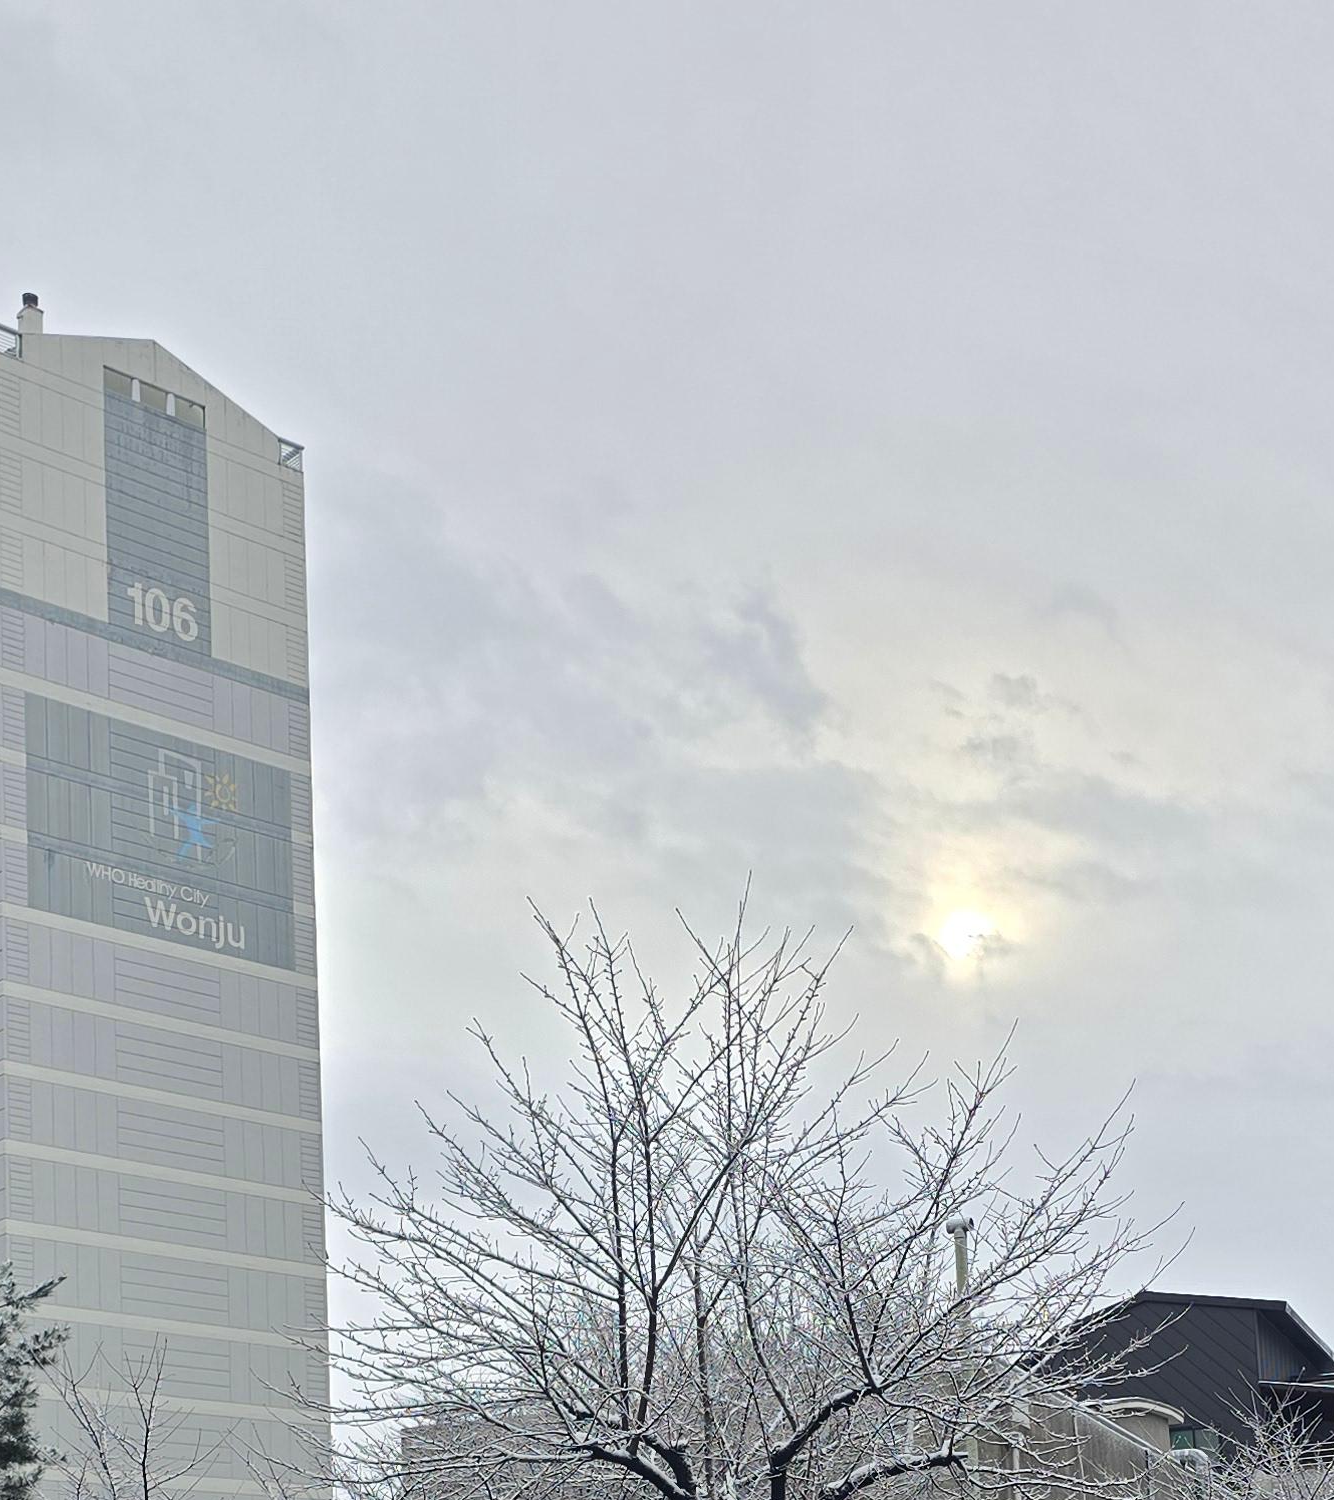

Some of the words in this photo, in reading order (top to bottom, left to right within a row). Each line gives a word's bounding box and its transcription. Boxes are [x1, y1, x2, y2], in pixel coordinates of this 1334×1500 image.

[127, 582, 198, 642] 106
[85, 861, 125, 885] WHO
[180, 886, 210, 909] City
[144, 896, 246, 950] Wonju
